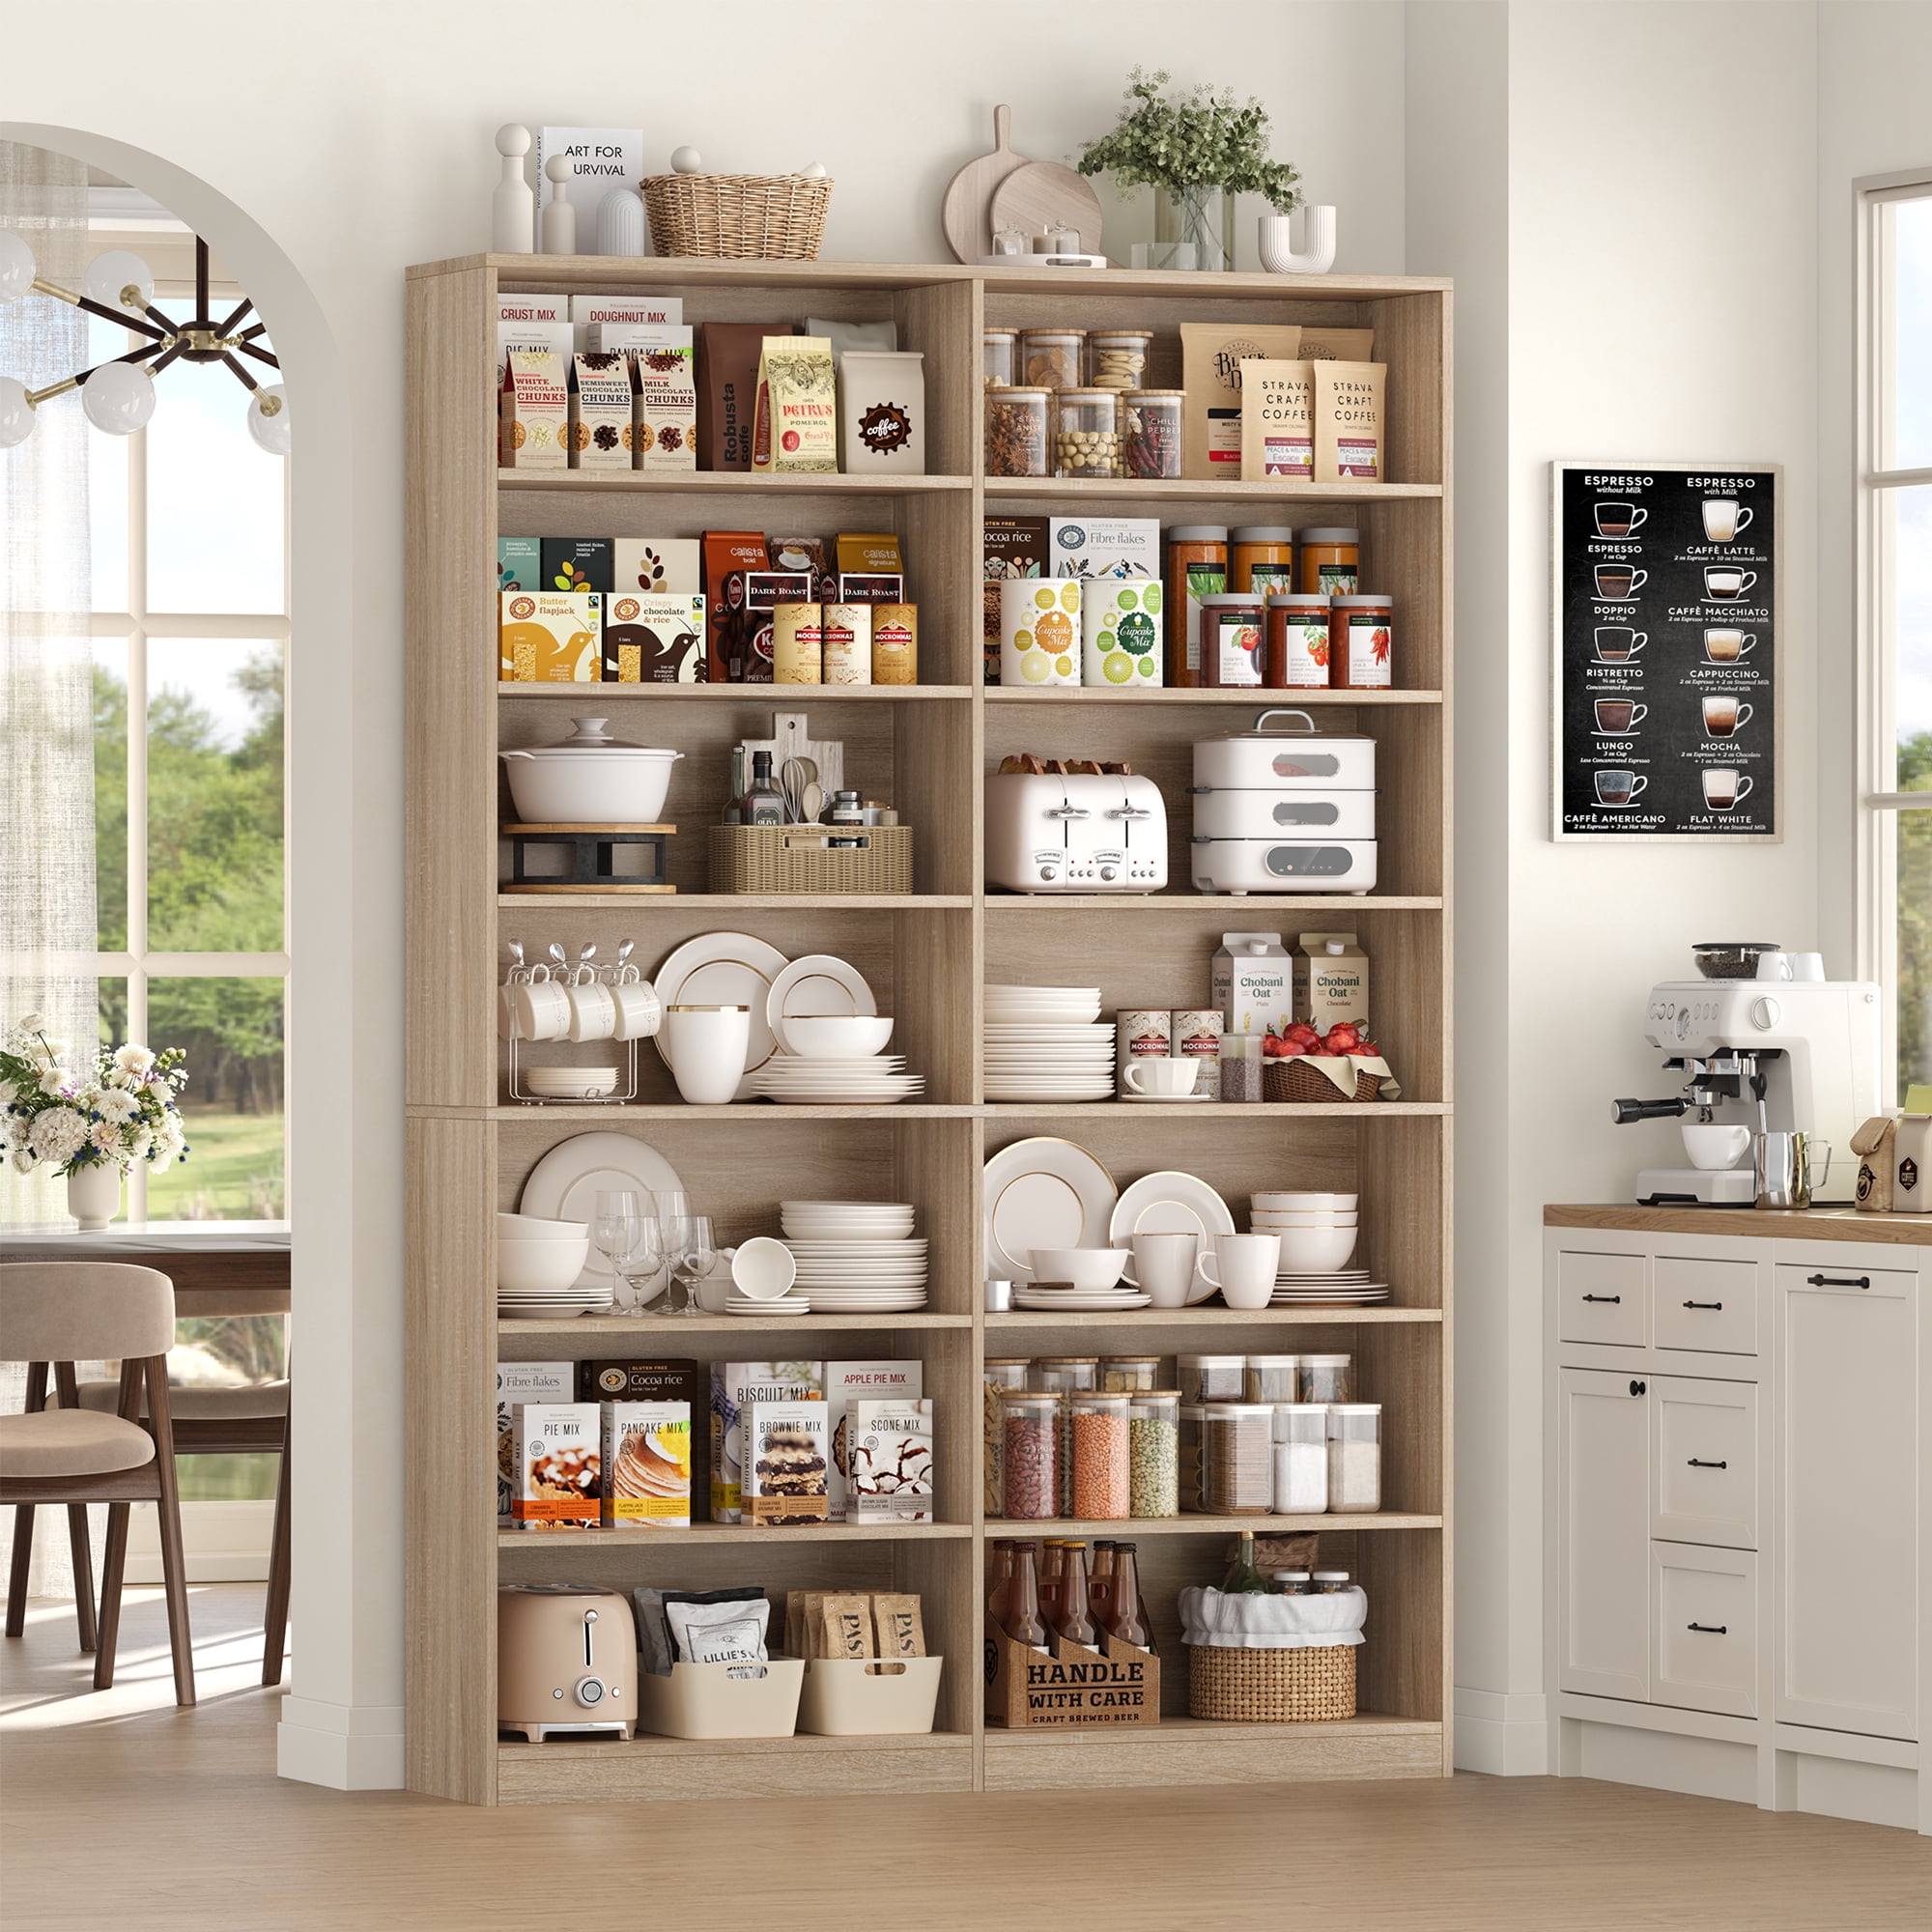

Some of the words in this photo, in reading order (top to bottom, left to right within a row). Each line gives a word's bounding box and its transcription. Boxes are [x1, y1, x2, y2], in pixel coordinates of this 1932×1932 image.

[565, 145, 589, 156] ART
[595, 147, 622, 157] FOR
[573, 163, 625, 176] URVIVAL
[500, 309, 534, 320] CRUST
[537, 309, 556, 320] MIX
[590, 310, 645, 323] DOUGHNUT
[647, 312, 667, 323] MIX
[1262, 381, 1310, 390] STRAVA
[1333, 382, 1373, 392] STRAVA
[517, 392, 566, 401] CHUNKS
[582, 393, 631, 403] CHUNKS
[645, 395, 695, 404] CHUNKS
[1265, 394, 1308, 405] CRAFT
[1337, 395, 1372, 406] CRAFT
[1262, 409, 1313, 420] COFFEE
[1334, 410, 1376, 422] COFFEE
[723, 383, 737, 462] Robusta
[867, 417, 899, 437] coffee
[739, 425, 749, 463] coffe
[1584, 475, 1654, 486] ESPRESSO
[1687, 477, 1755, 488] ESPRESSO
[984, 532, 1009, 542] ocoa
[1012, 530, 1032, 542] rice
[1090, 532, 1115, 543] Fibre
[1117, 532, 1146, 544] flakes
[1588, 545, 1642, 554] ESPRESSO
[1687, 545, 1719, 554] CAFFÈ
[643, 599, 672, 608] Crispy
[539, 607, 575, 615] flapjack
[1668, 606, 1701, 615] CAFFÈ
[1705, 608, 1769, 616] MACCHIATO
[1120, 625, 1153, 638] Cupcake
[1129, 636, 1151, 646] Mix
[1586, 668, 1643, 677] RISTRETTO
[1690, 669, 1759, 678] CAPPUCCINO
[1564, 813, 1598, 823] CAFFÈ
[1602, 814, 1666, 823] AMERICANO
[1240, 977, 1283, 986] Chobani
[1317, 976, 1360, 986] Chobani
[1252, 988, 1271, 998] Oat
[1328, 987, 1348, 997] Oat
[506, 1376, 531, 1386] Fibre
[532, 1375, 560, 1386] flakes
[631, 1374, 662, 1384] Cocoa
[665, 1374, 683, 1384] rice
[843, 1375, 871, 1383] APPLE
[873, 1374, 887, 1383] PIE
[890, 1374, 906, 1382] MIX
[737, 1387, 784, 1403] BISCUIT
[790, 1387, 811, 1401] MIX
[544, 1424, 558, 1435] PIE
[563, 1424, 580, 1435] MIX
[621, 1422, 662, 1435] PANCAKE
[667, 1422, 683, 1434] MIX
[759, 1421, 801, 1433] BROWNIE
[805, 1421, 821, 1432] MIX
[871, 1419, 900, 1431] SCONE
[903, 1419, 921, 1431] MIX
[703, 1650, 747, 1663] LILLIE'S
[1027, 1662, 1144, 1684] HANDLE
[1029, 1692, 1083, 1708] WITH
[1090, 1691, 1144, 1707] CARE
